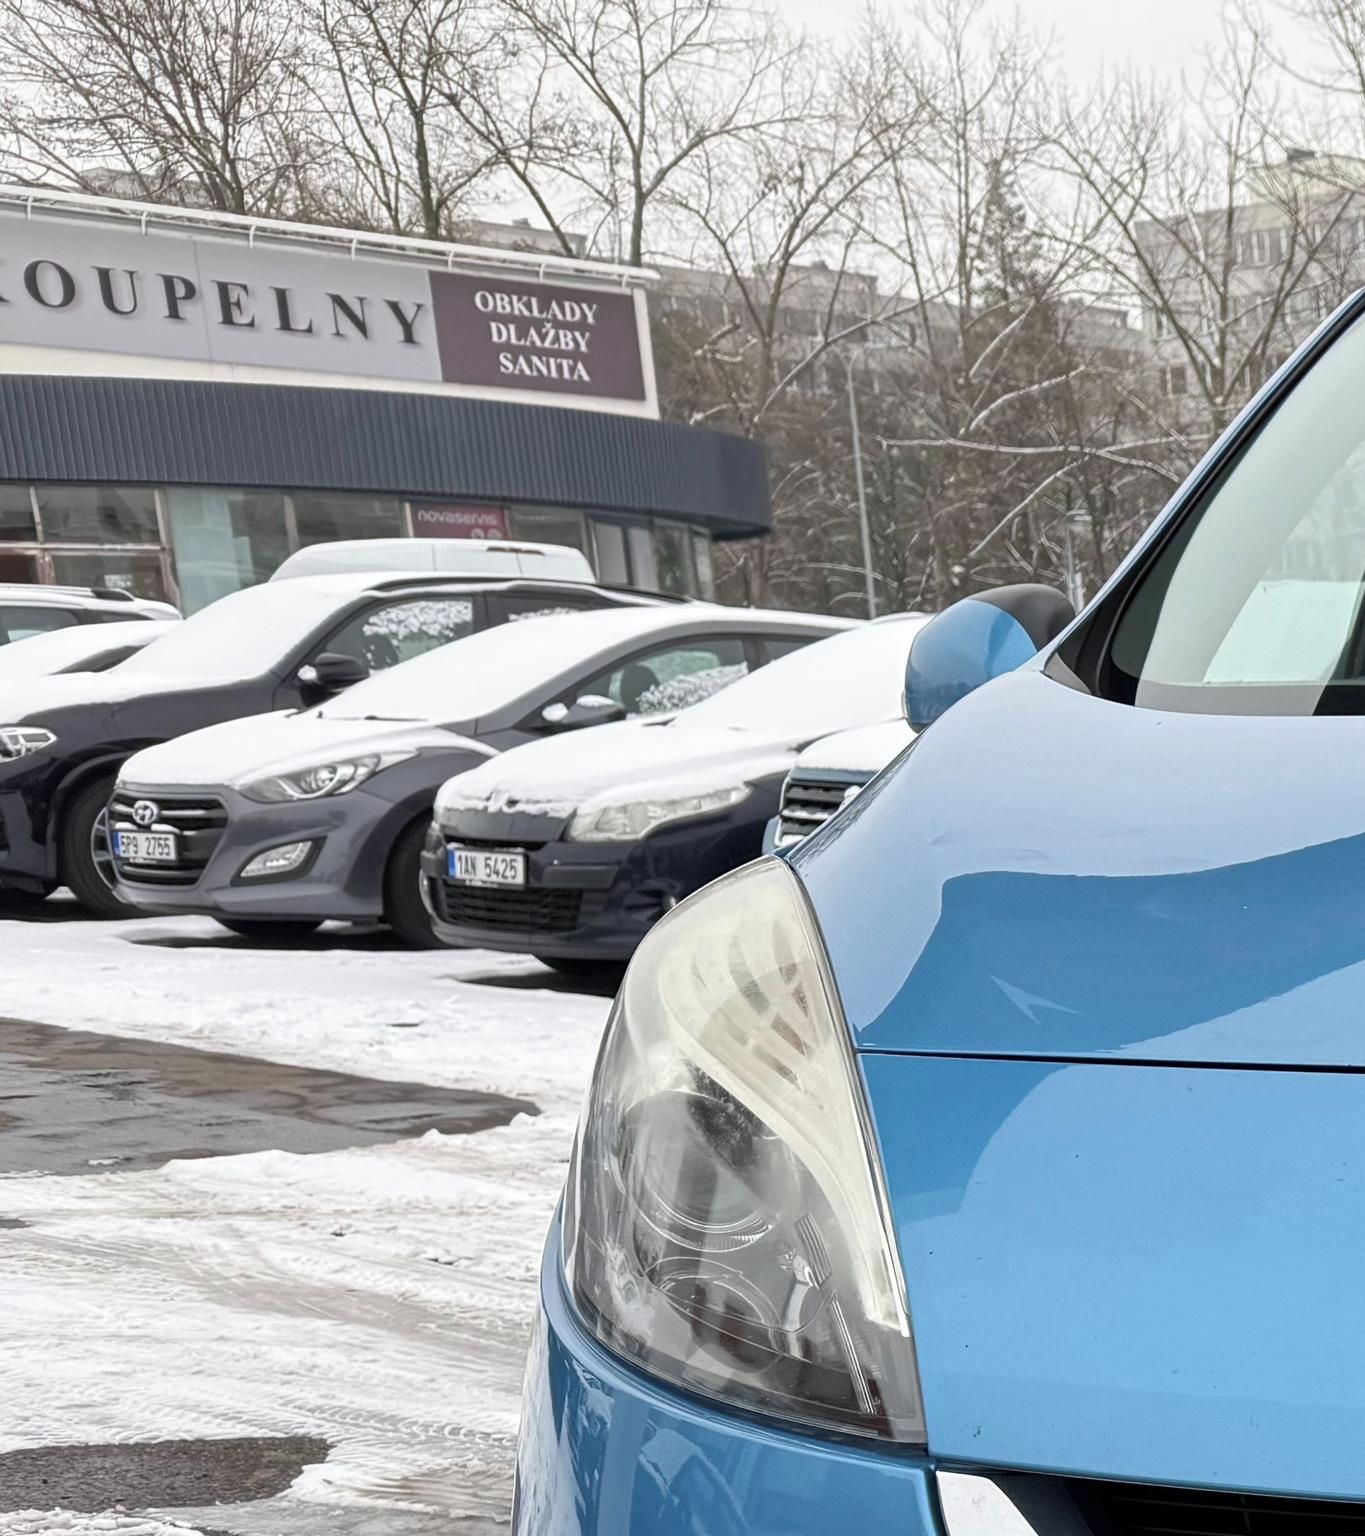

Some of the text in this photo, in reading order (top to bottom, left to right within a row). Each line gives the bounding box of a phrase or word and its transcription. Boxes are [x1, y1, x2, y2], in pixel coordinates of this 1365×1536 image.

[0, 260, 426, 345] OUPELNY
[474, 290, 597, 325] OBKLADY
[489, 321, 590, 353] DLAŽBY
[499, 352, 591, 382] SANITA
[417, 510, 498, 526] novaservis
[120, 835, 171, 856] 5P9 2755
[457, 854, 517, 880] 1AN 5425
